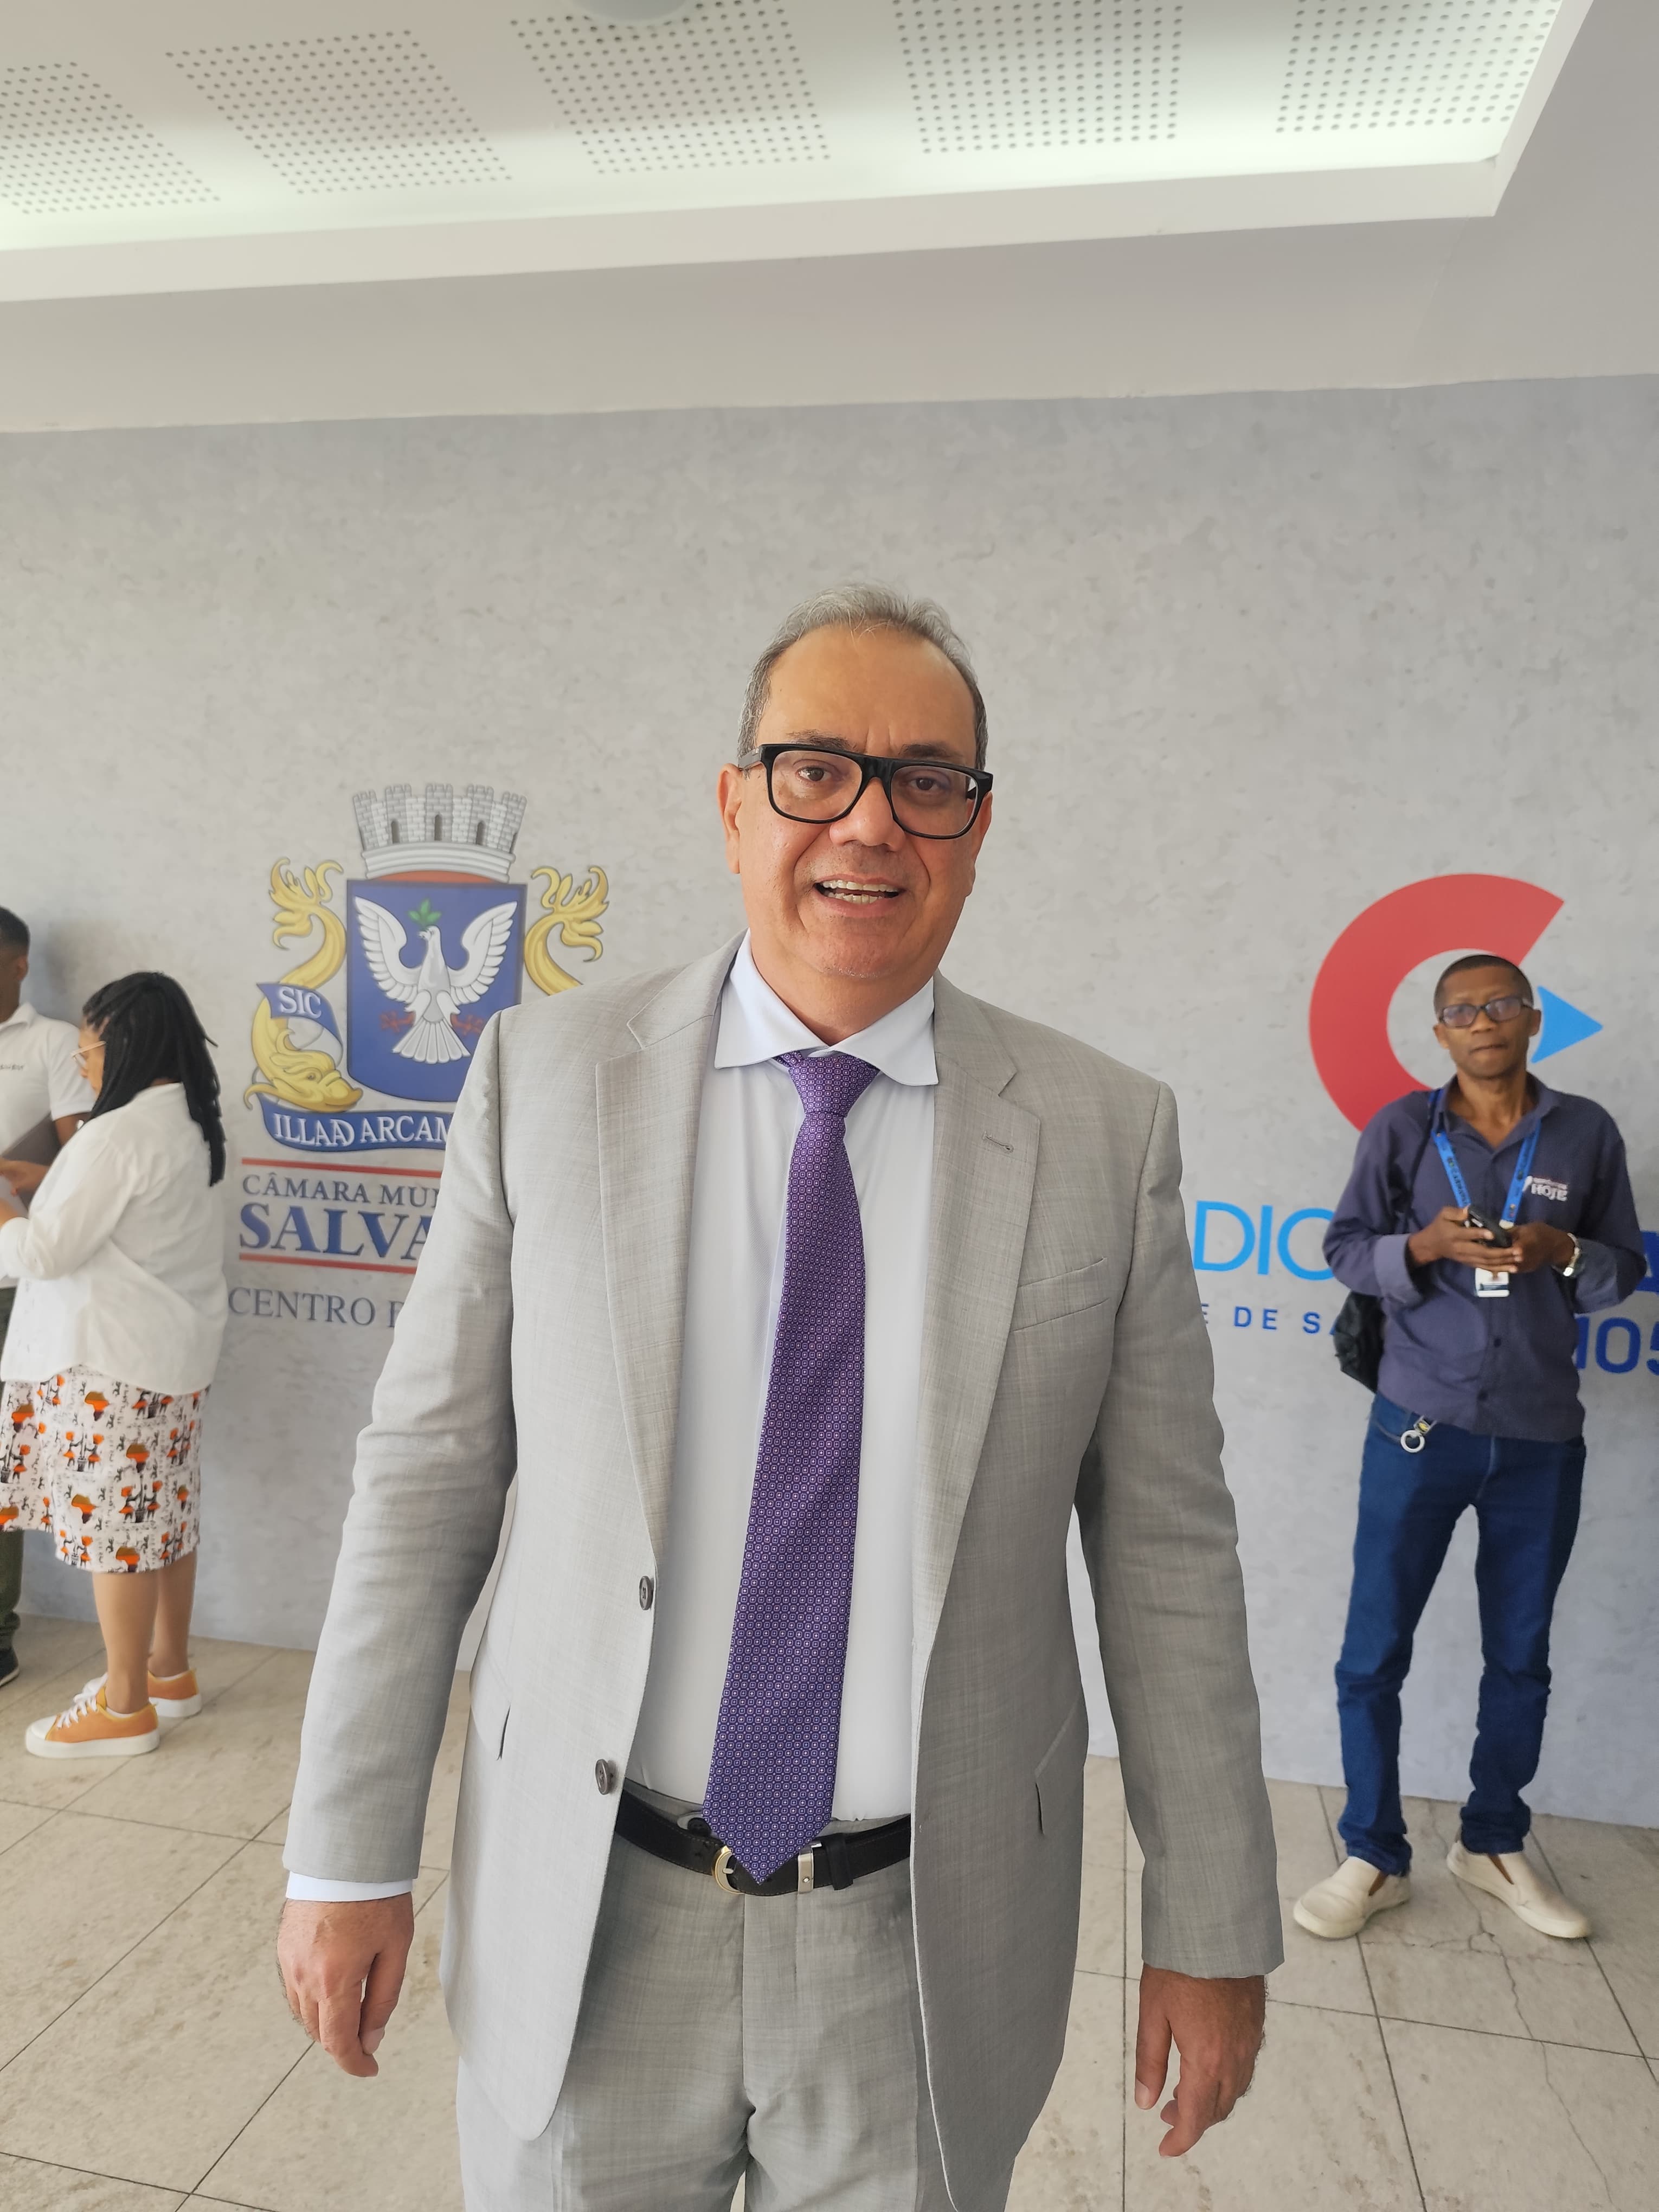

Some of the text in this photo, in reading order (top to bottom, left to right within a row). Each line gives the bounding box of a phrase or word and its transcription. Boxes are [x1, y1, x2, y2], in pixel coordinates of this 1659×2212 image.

[278, 986, 321, 1019] SIC
[243, 1172, 371, 1204] CÂMARA
[228, 1287, 376, 1326] CENTRO
[1234, 1306, 1278, 1330] DE
